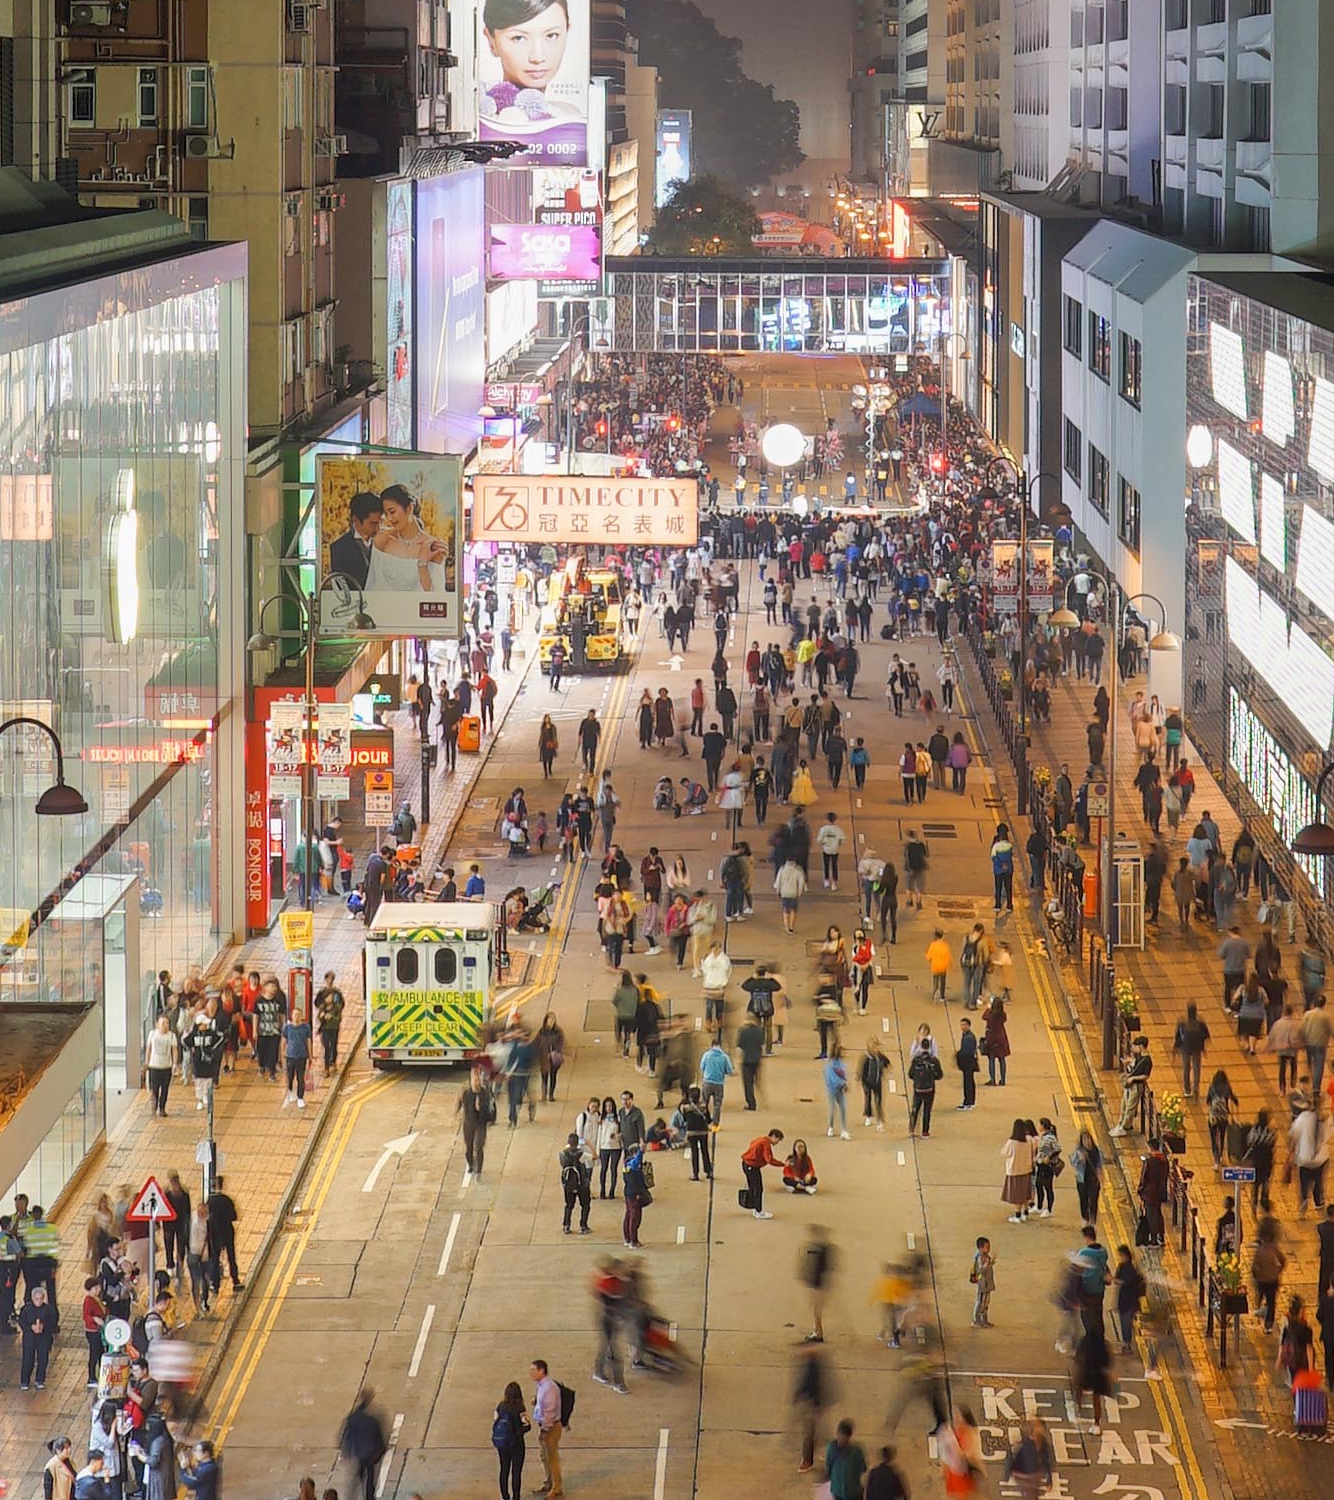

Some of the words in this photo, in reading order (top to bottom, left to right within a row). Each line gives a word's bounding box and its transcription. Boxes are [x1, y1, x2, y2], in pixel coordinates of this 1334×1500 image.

[536, 485, 686, 508] TIMECITY
[539, 513, 685, 535] 冠亞名表城
[248, 838, 262, 902] BONJOUR
[392, 992, 460, 1004] AMBULANCE
[397, 1023, 423, 1033] KEEP
[426, 1023, 459, 1033] CLEAR
[114, 1327, 123, 1340] 3
